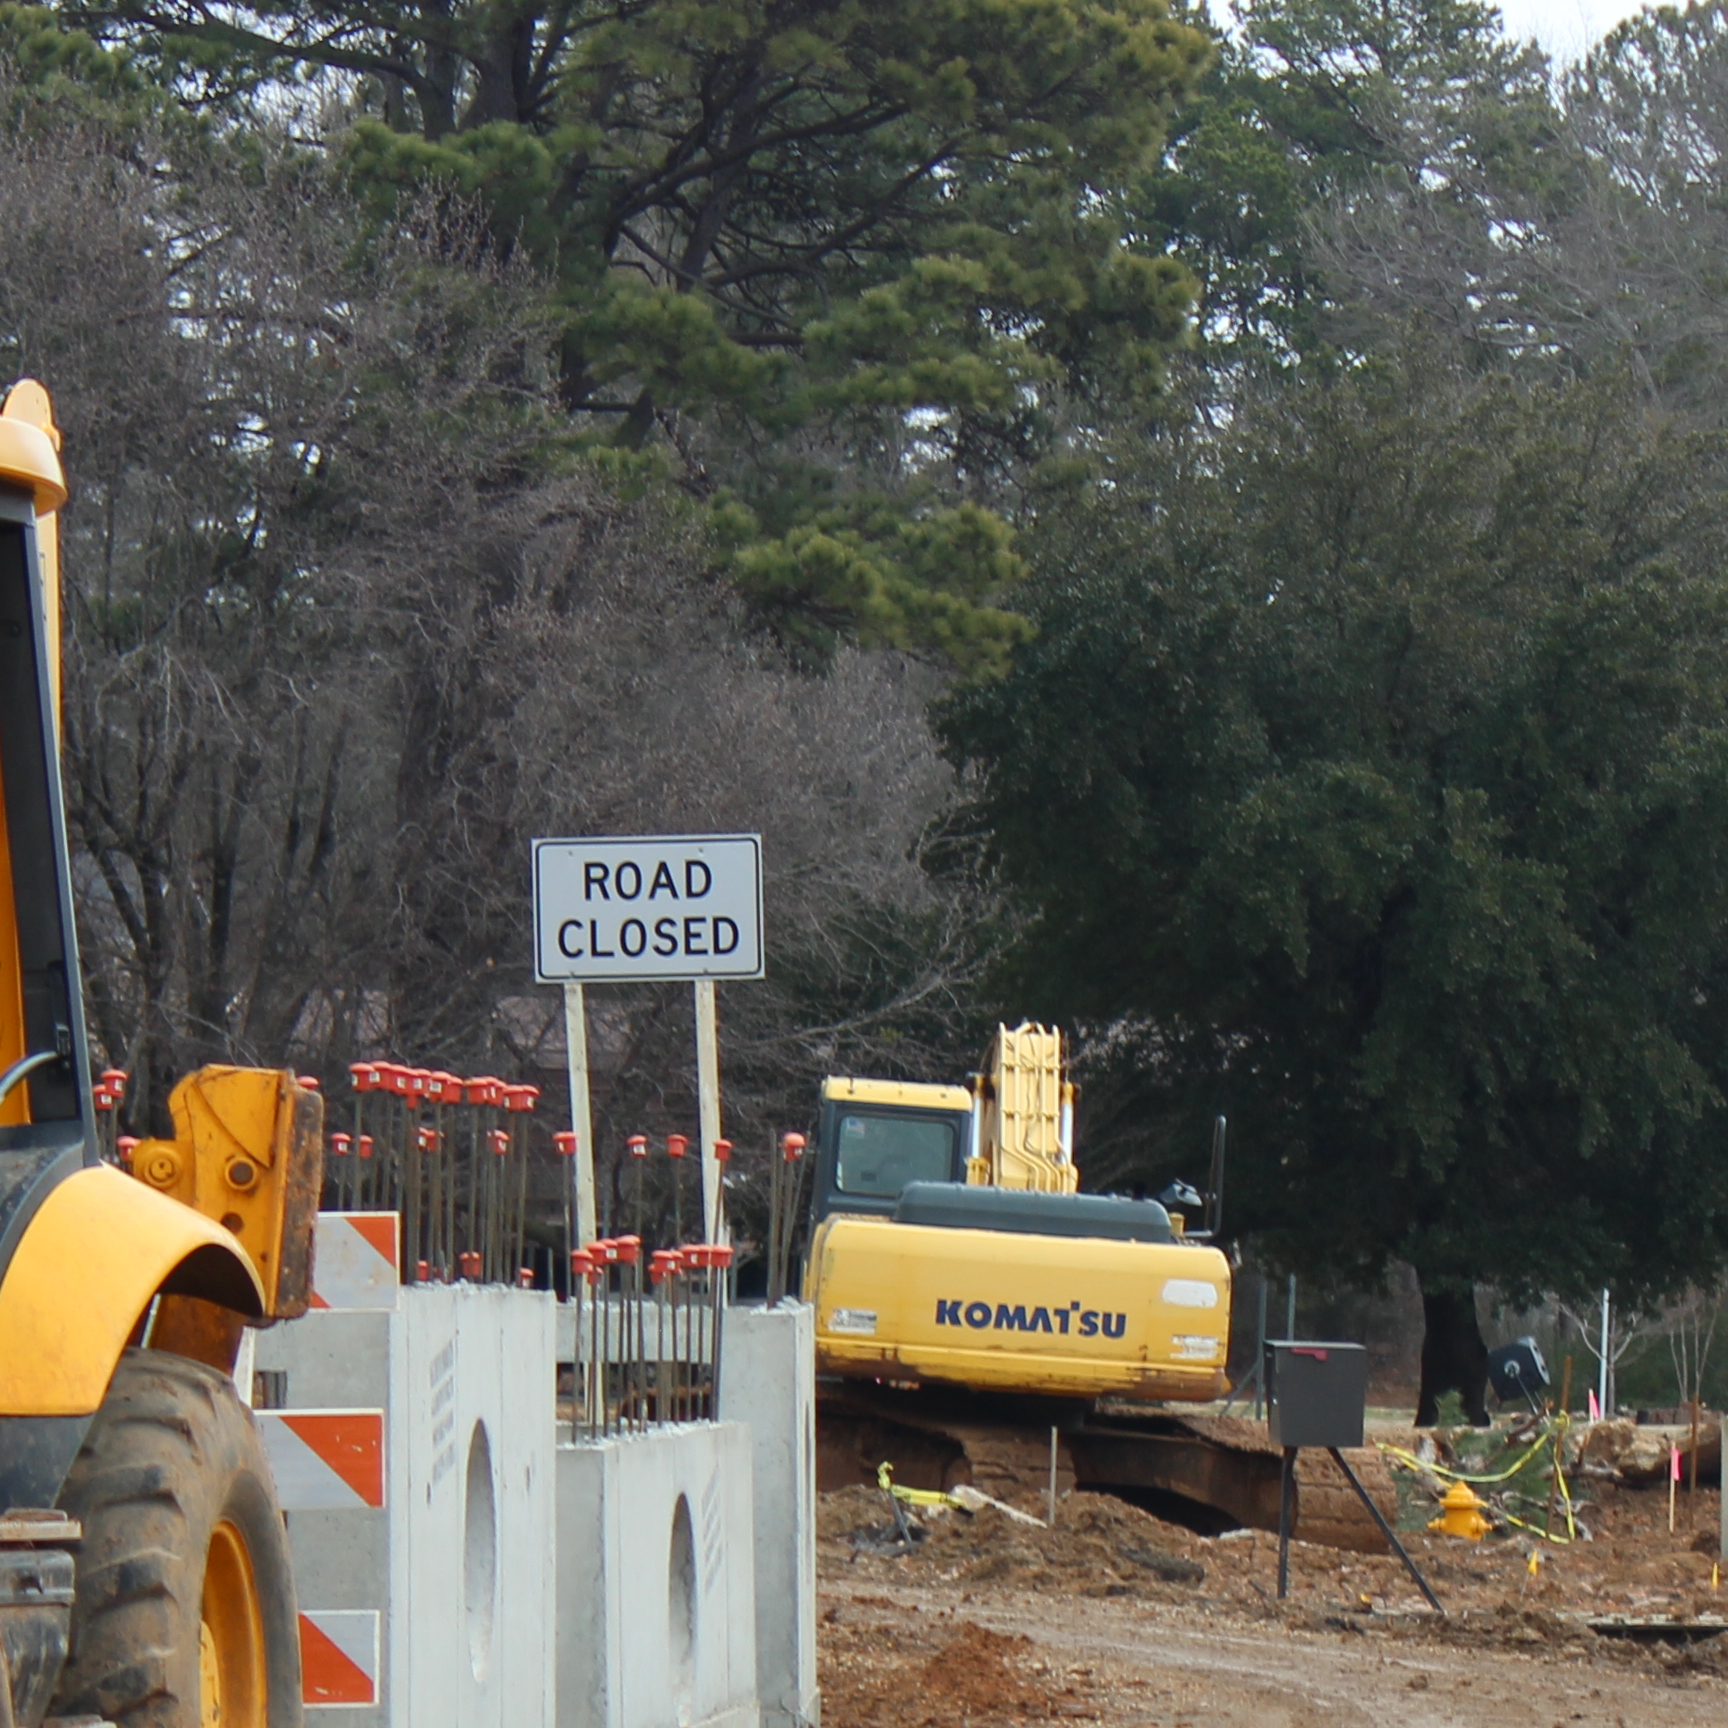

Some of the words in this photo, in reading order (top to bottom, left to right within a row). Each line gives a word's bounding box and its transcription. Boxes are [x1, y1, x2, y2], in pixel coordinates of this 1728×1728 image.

[583, 859, 713, 901] ROAD
[557, 916, 740, 960] CLOSED
[935, 1298, 1127, 1339] KOMATSU
